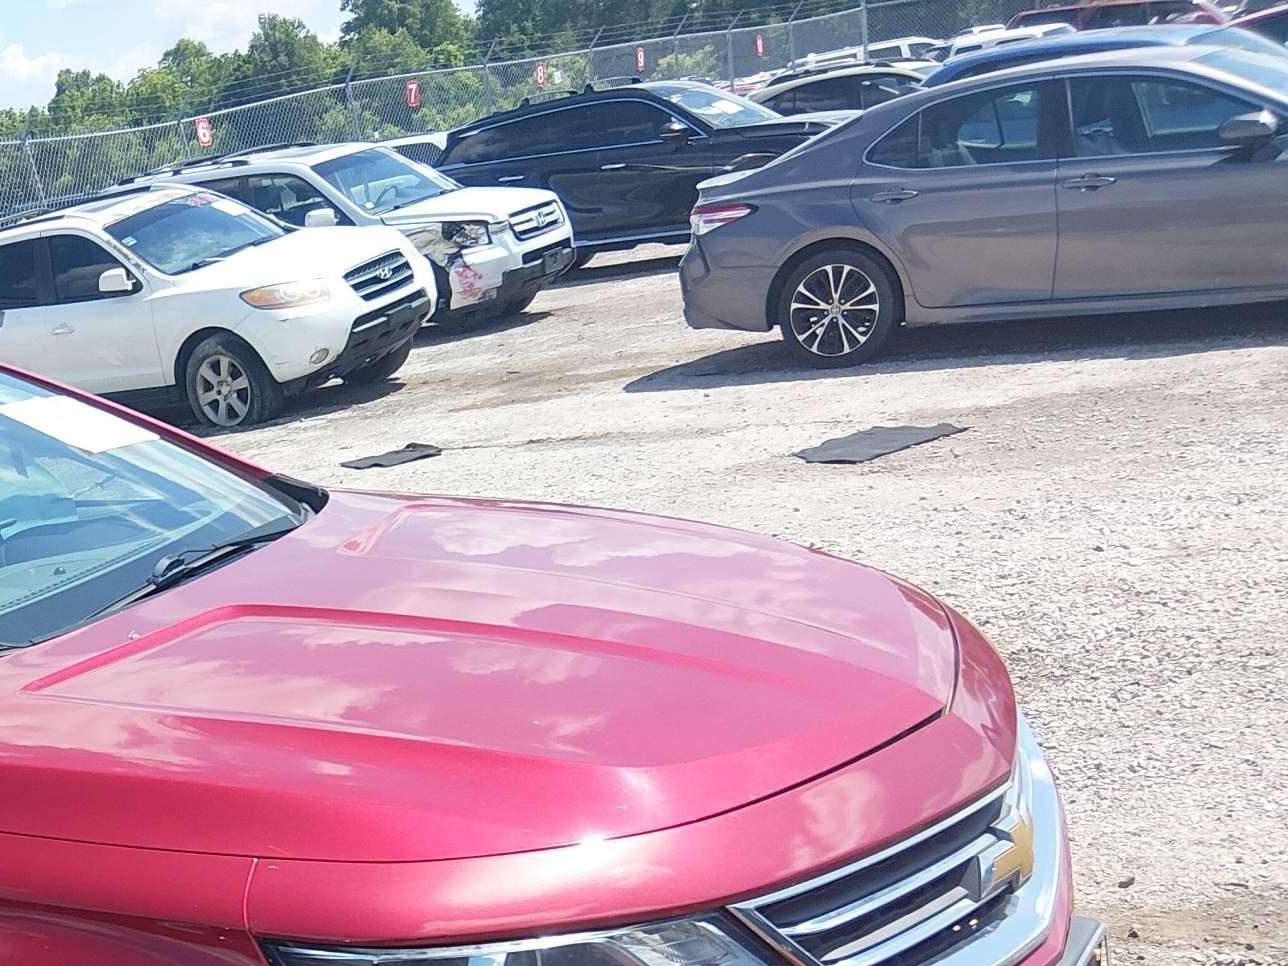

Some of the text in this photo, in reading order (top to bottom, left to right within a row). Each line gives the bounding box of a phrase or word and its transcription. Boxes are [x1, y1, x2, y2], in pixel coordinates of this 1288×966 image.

[637, 49, 644, 68] 9
[536, 64, 544, 85] 8
[409, 83, 417, 103] 7
[198, 121, 211, 143] 6
